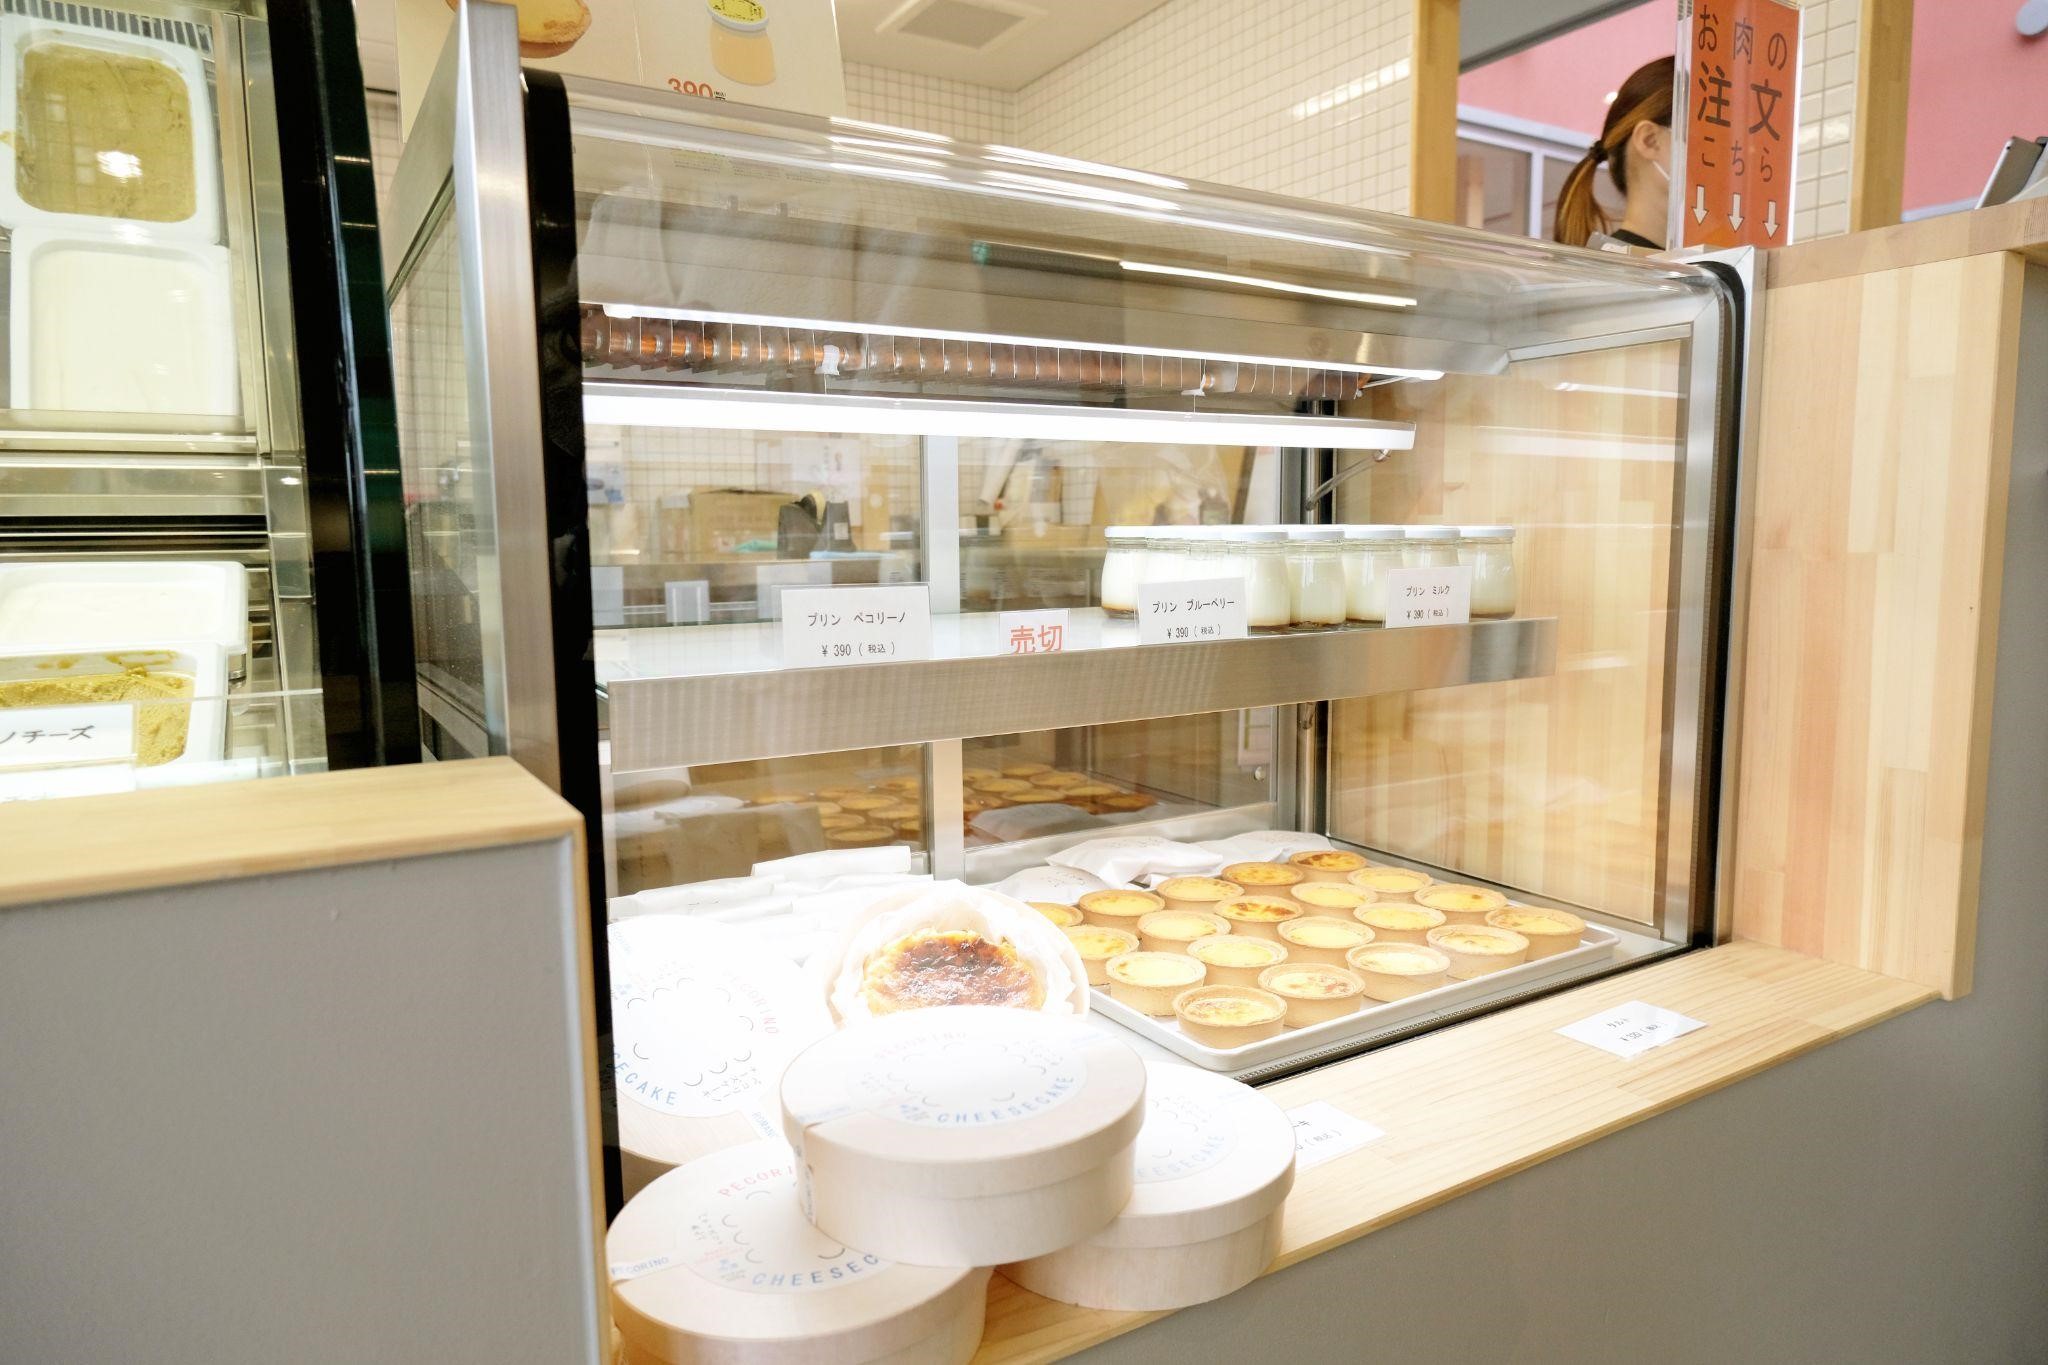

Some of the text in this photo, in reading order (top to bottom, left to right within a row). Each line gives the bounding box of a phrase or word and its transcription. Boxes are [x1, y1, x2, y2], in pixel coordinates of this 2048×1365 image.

[807, 611, 841, 627] プリン
[1010, 624, 1063, 655] 売切
